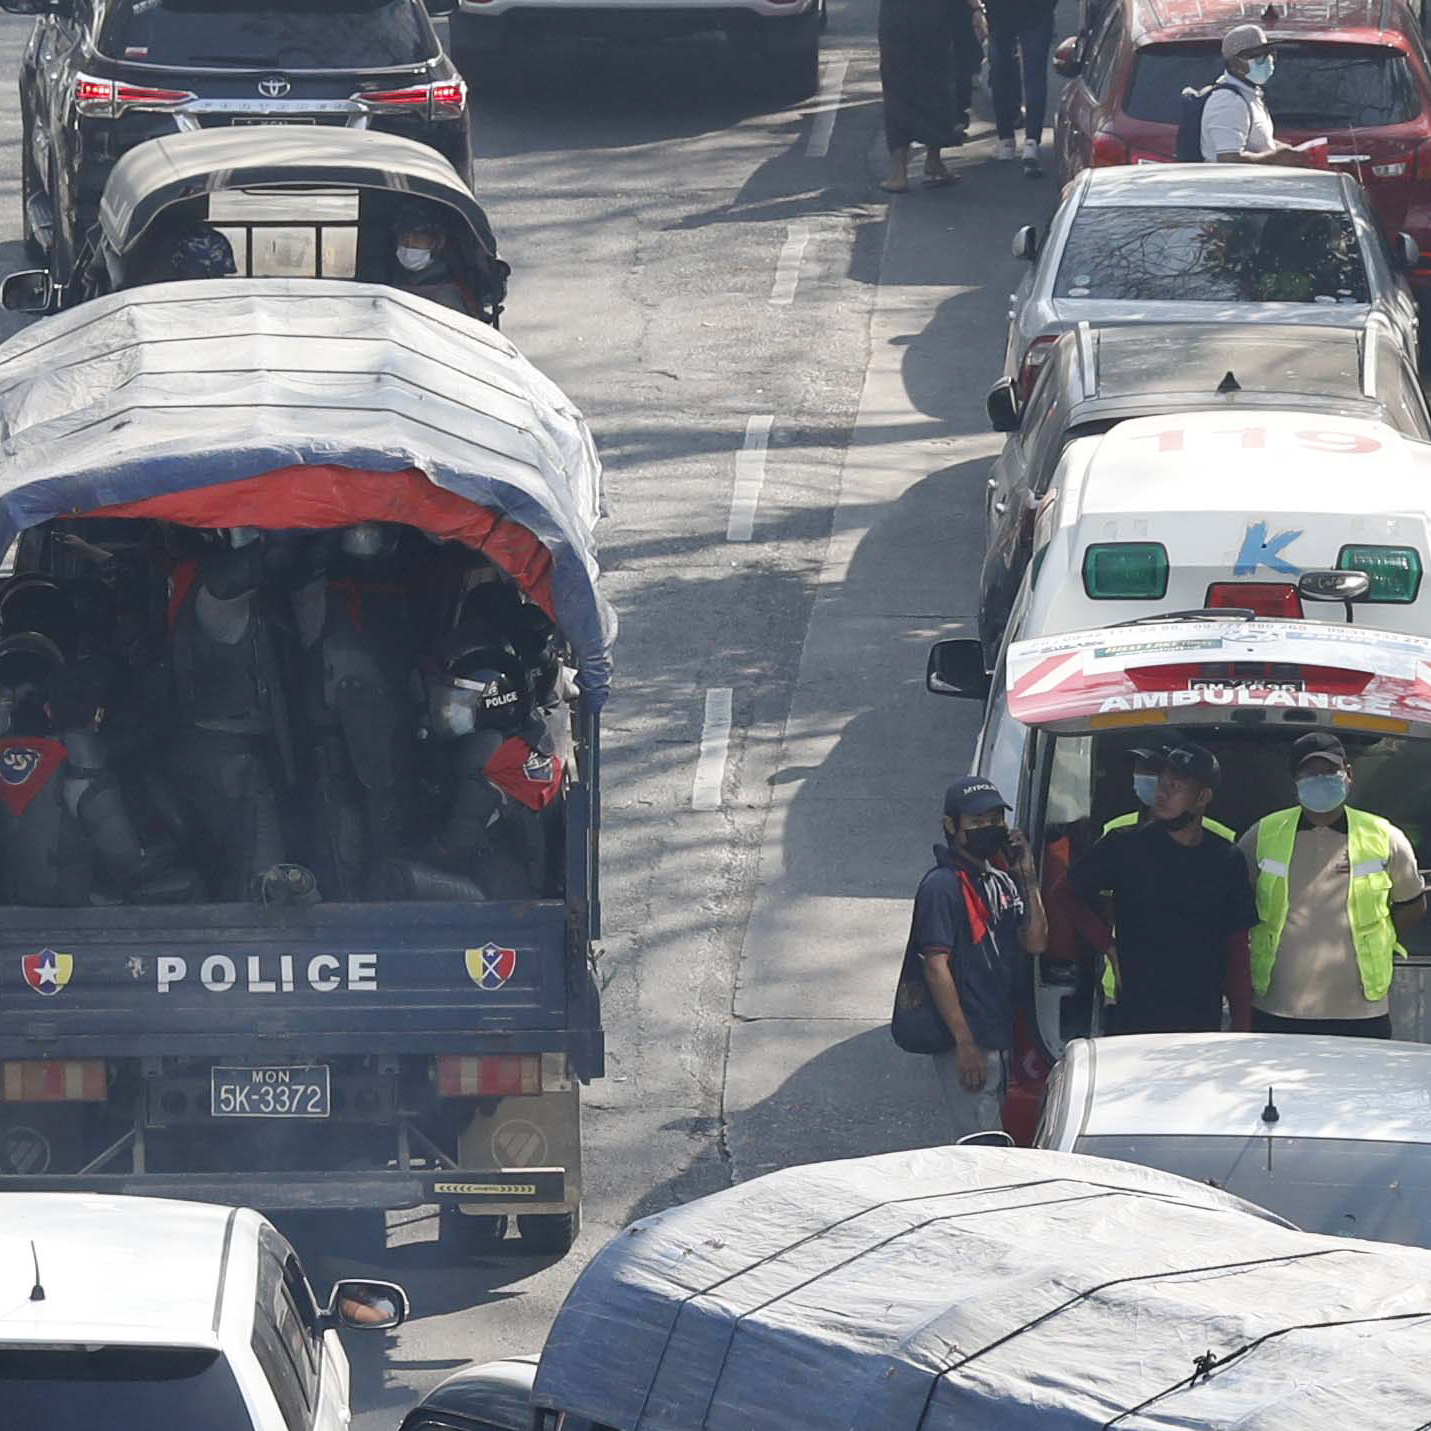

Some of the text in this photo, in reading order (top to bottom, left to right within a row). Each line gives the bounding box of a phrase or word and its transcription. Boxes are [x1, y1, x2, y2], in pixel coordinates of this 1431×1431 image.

[1129, 427, 1382, 454] 119
[1234, 519, 1304, 577] K
[485, 691, 519, 709] POLICE
[1098, 680, 1396, 716] AMBULANCE
[157, 954, 377, 993] POLICE
[252, 1071, 291, 1083] MON
[220, 1085, 322, 1113] 5K-3372
